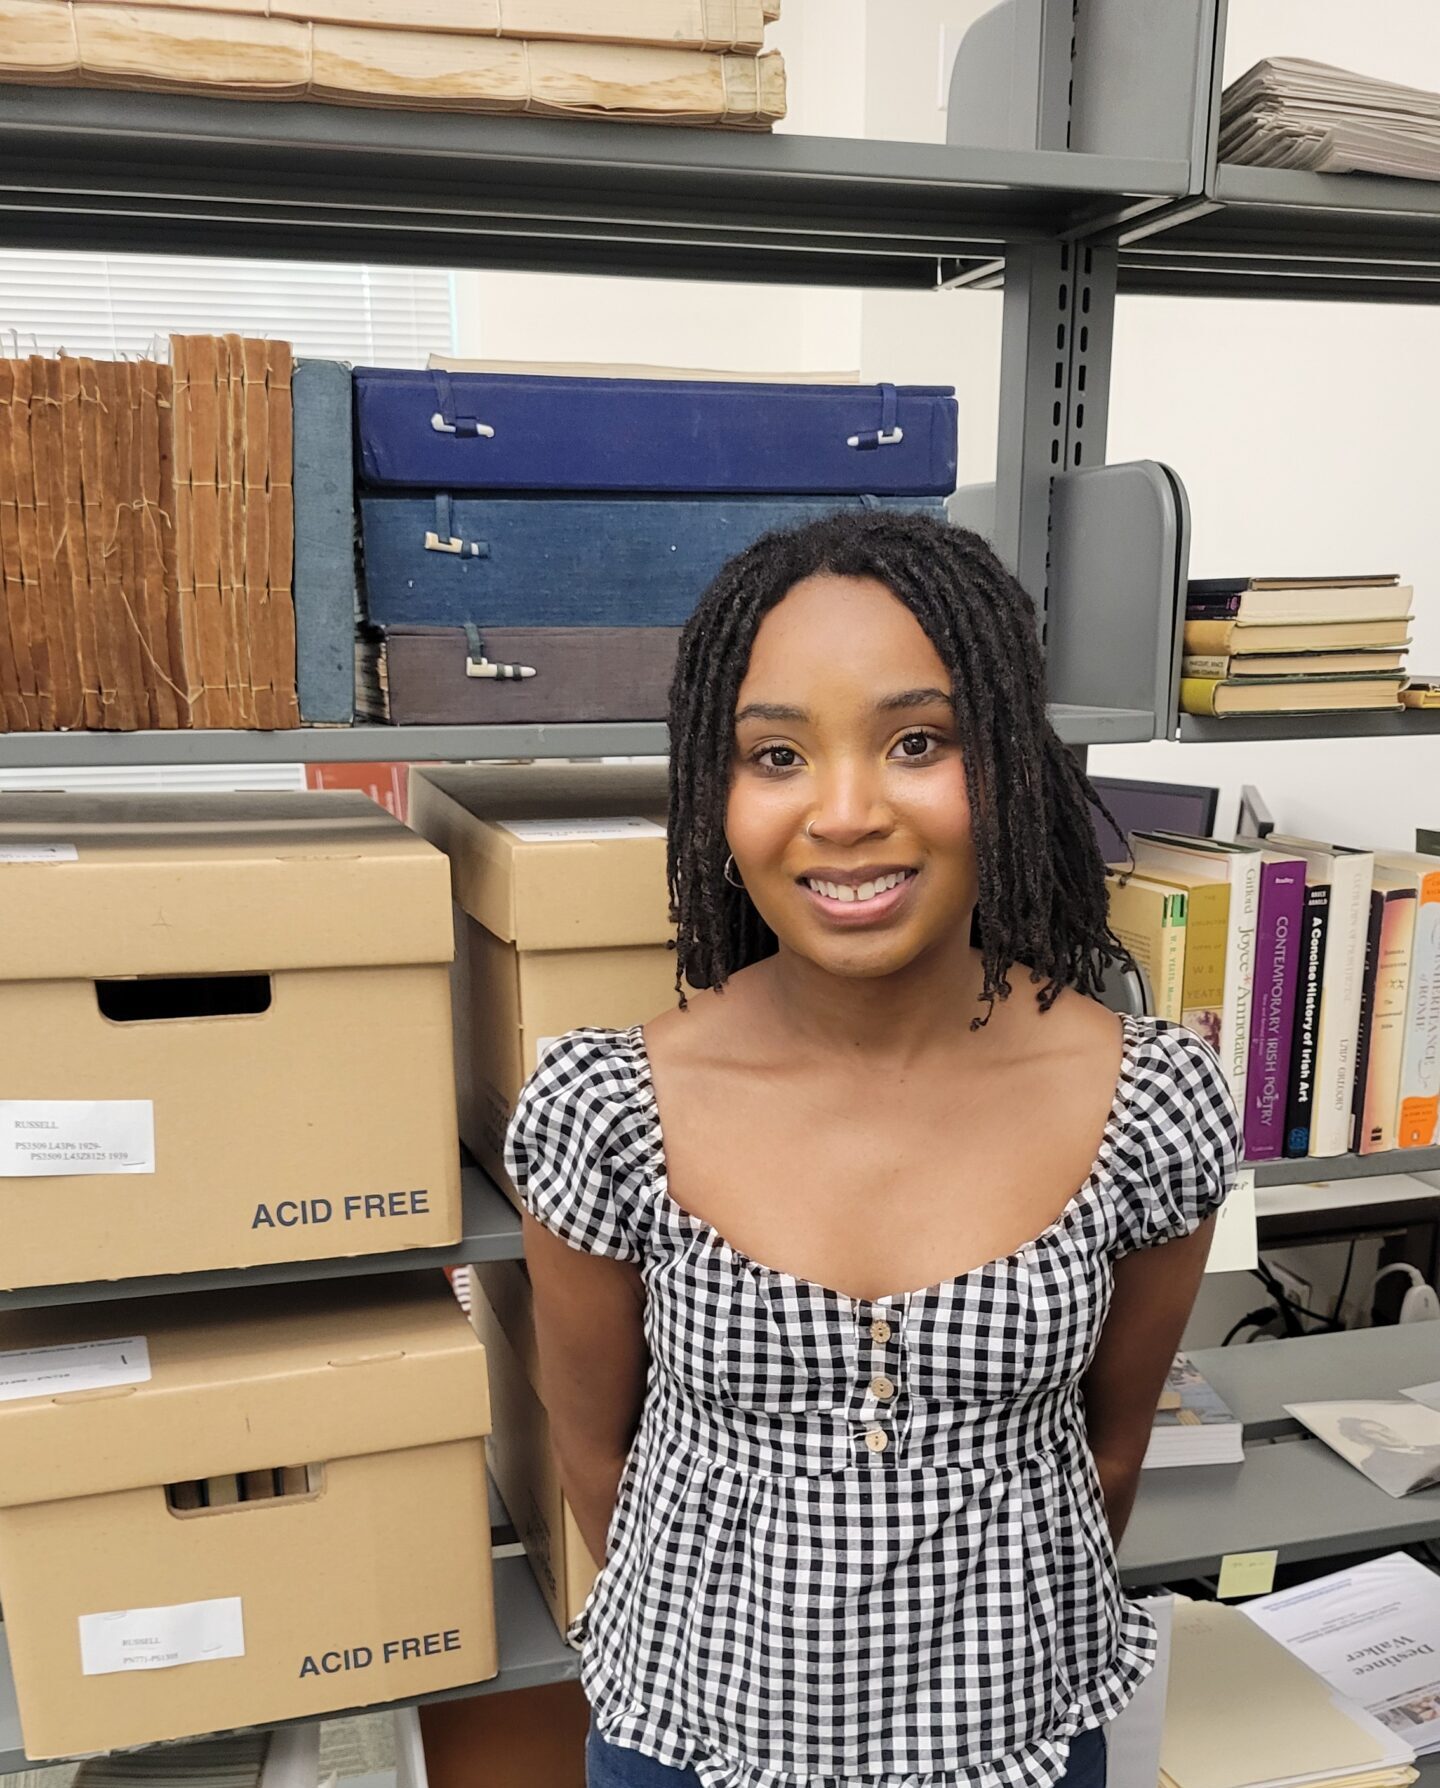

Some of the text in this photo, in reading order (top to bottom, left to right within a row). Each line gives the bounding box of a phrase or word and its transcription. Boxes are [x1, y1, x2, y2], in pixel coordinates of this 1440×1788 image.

[1236, 926, 1255, 975] Joyce
[1232, 986, 1252, 1077] Annotated
[1260, 915, 1289, 1127] CONTEMPORARY IRISH POETRY
[1298, 916, 1322, 1102] A Concise History of Irish Art
[14, 1120, 59, 1130] RUSSELL
[252, 1189, 430, 1229] ACID FREE
[298, 1629, 461, 1678] ACID FREE
[1345, 1635, 1416, 1663] Walker
[1352, 1643, 1436, 1677] Destinee
